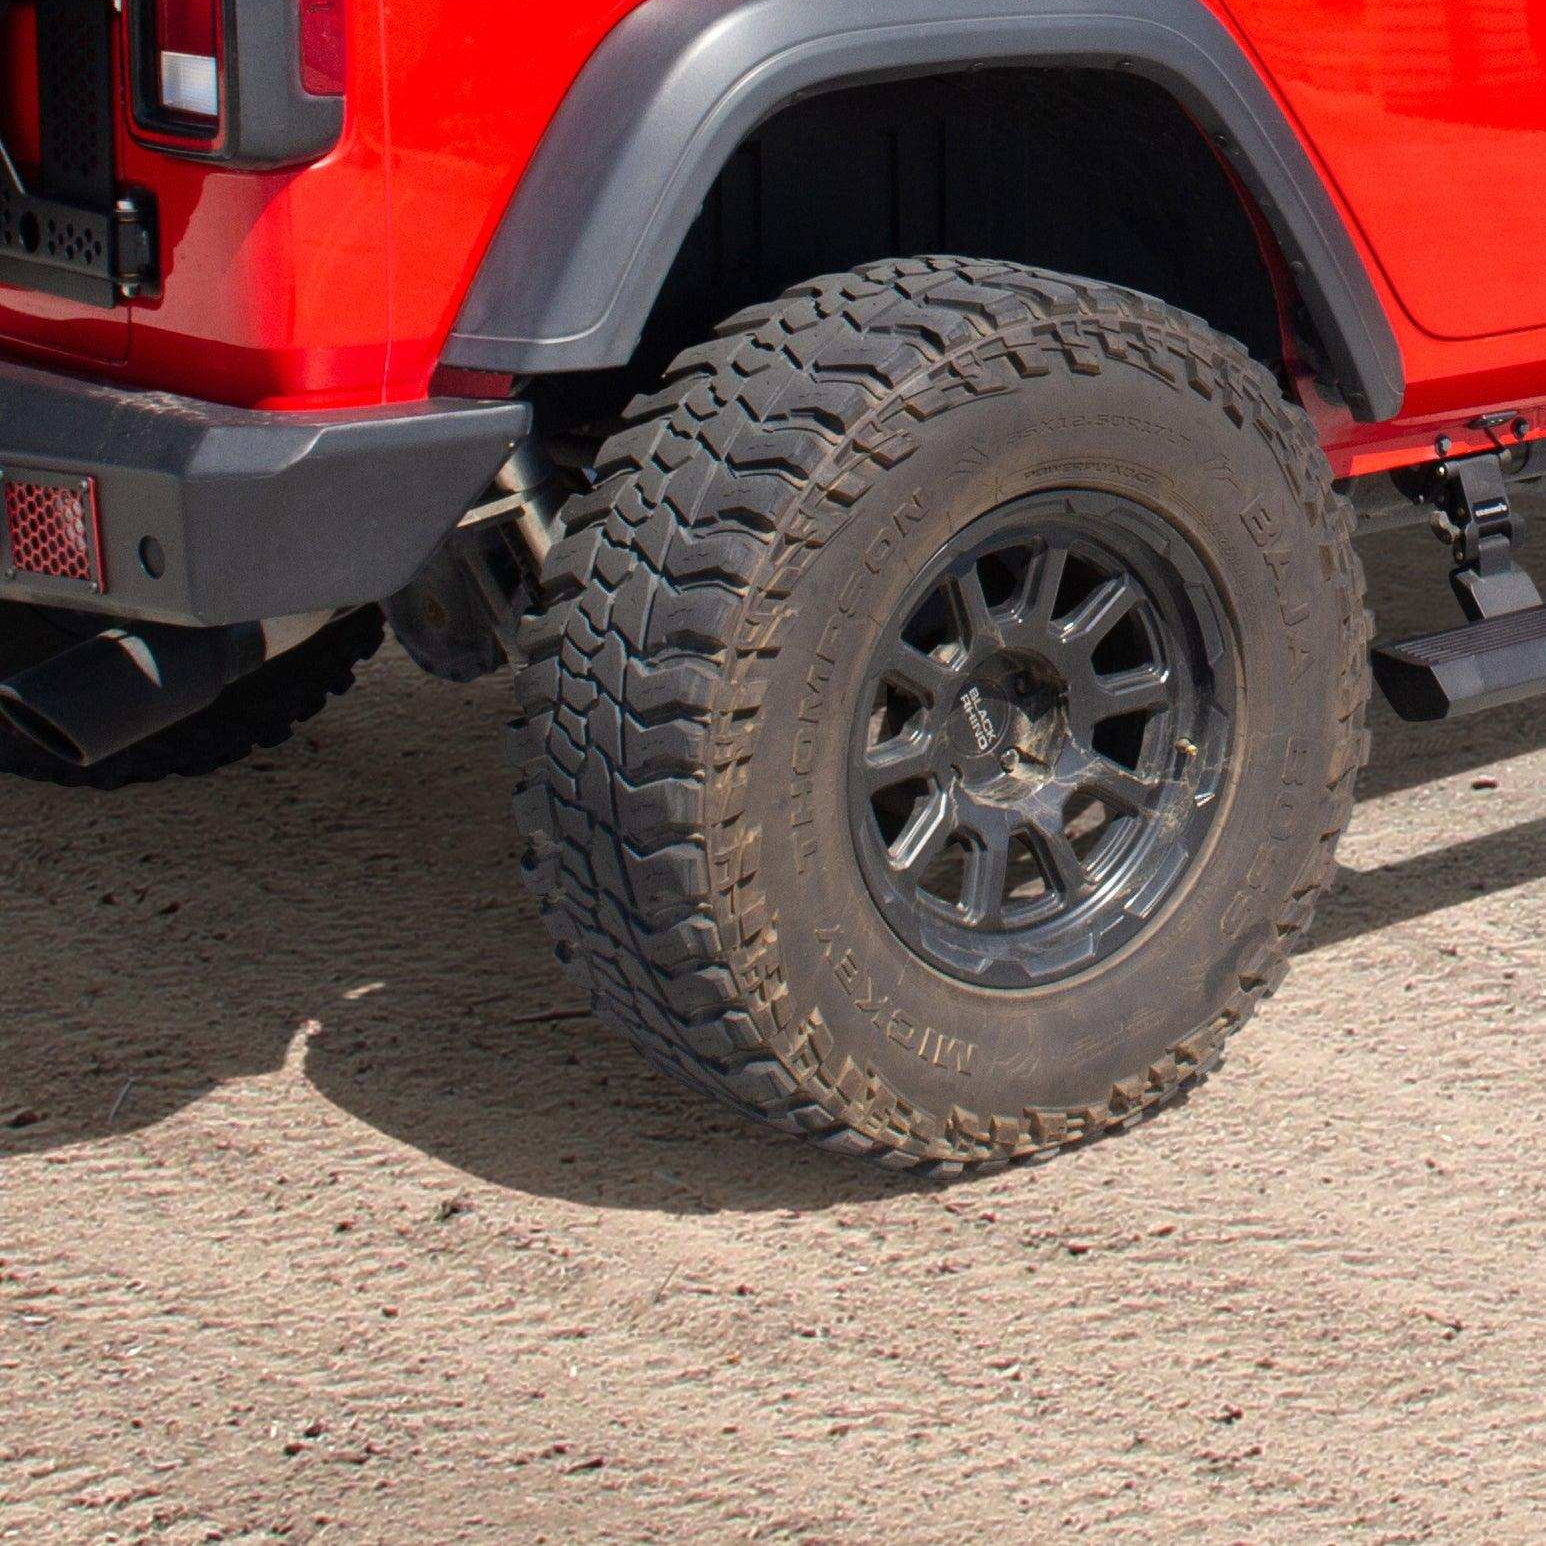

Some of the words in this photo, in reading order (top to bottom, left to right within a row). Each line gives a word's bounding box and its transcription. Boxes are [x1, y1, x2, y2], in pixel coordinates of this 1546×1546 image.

[1238, 491, 1317, 686] BAJA
[789, 485, 930, 875] THOMPSON
[960, 693, 989, 751] RHINO
[968, 686, 997, 745] BLACK
[1219, 735, 1318, 940] BOSS
[813, 923, 979, 1077] MICKEY
